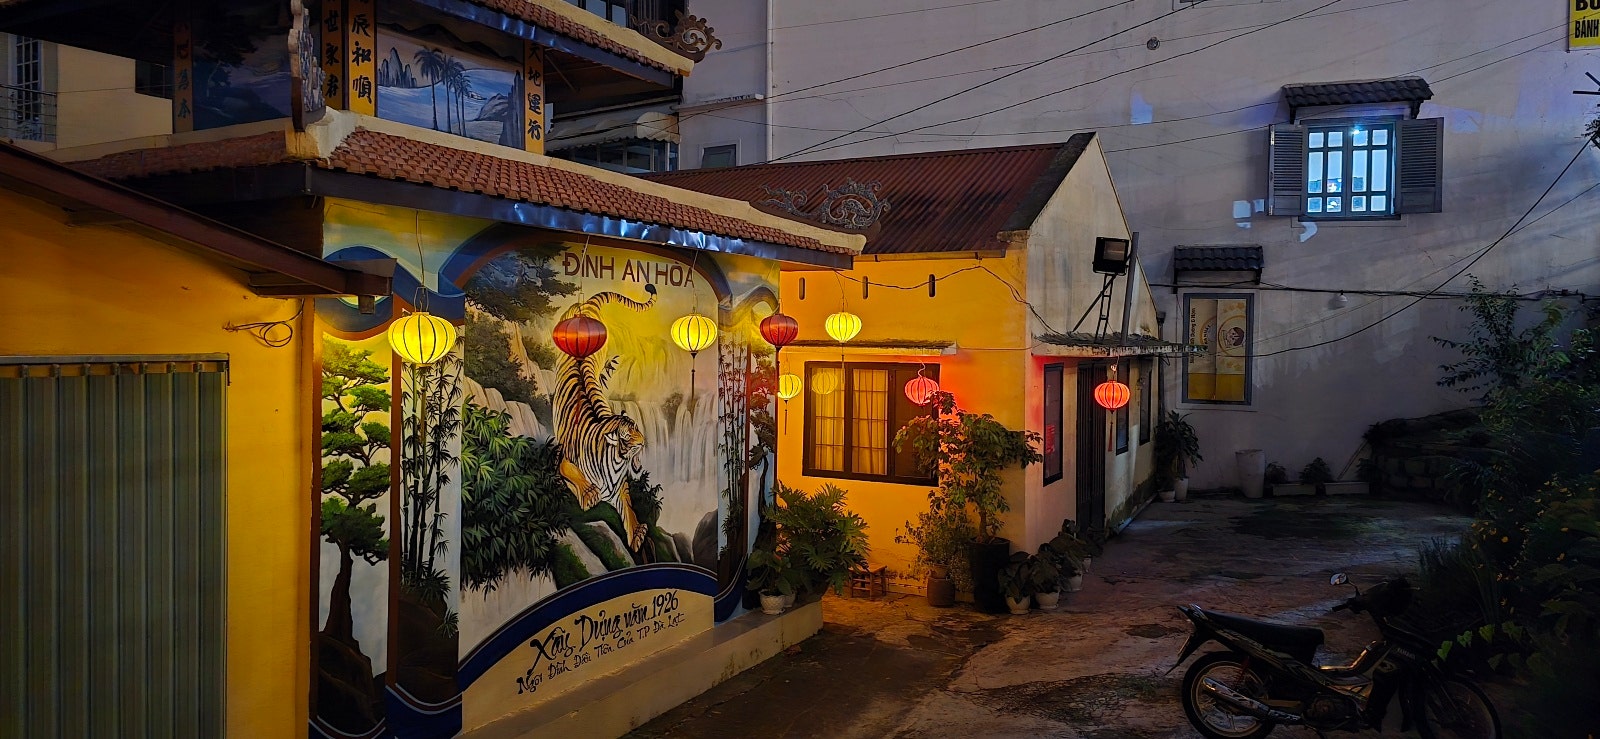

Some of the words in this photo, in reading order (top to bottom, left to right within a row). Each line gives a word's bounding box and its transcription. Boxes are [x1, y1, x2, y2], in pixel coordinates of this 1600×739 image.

[1574, 16, 1599, 38] BÁNH
[351, 0, 373, 104] 辰和順
[622, 258, 650, 283] AN
[655, 261, 695, 288] HÒA
[650, 590, 679, 619] 1926
